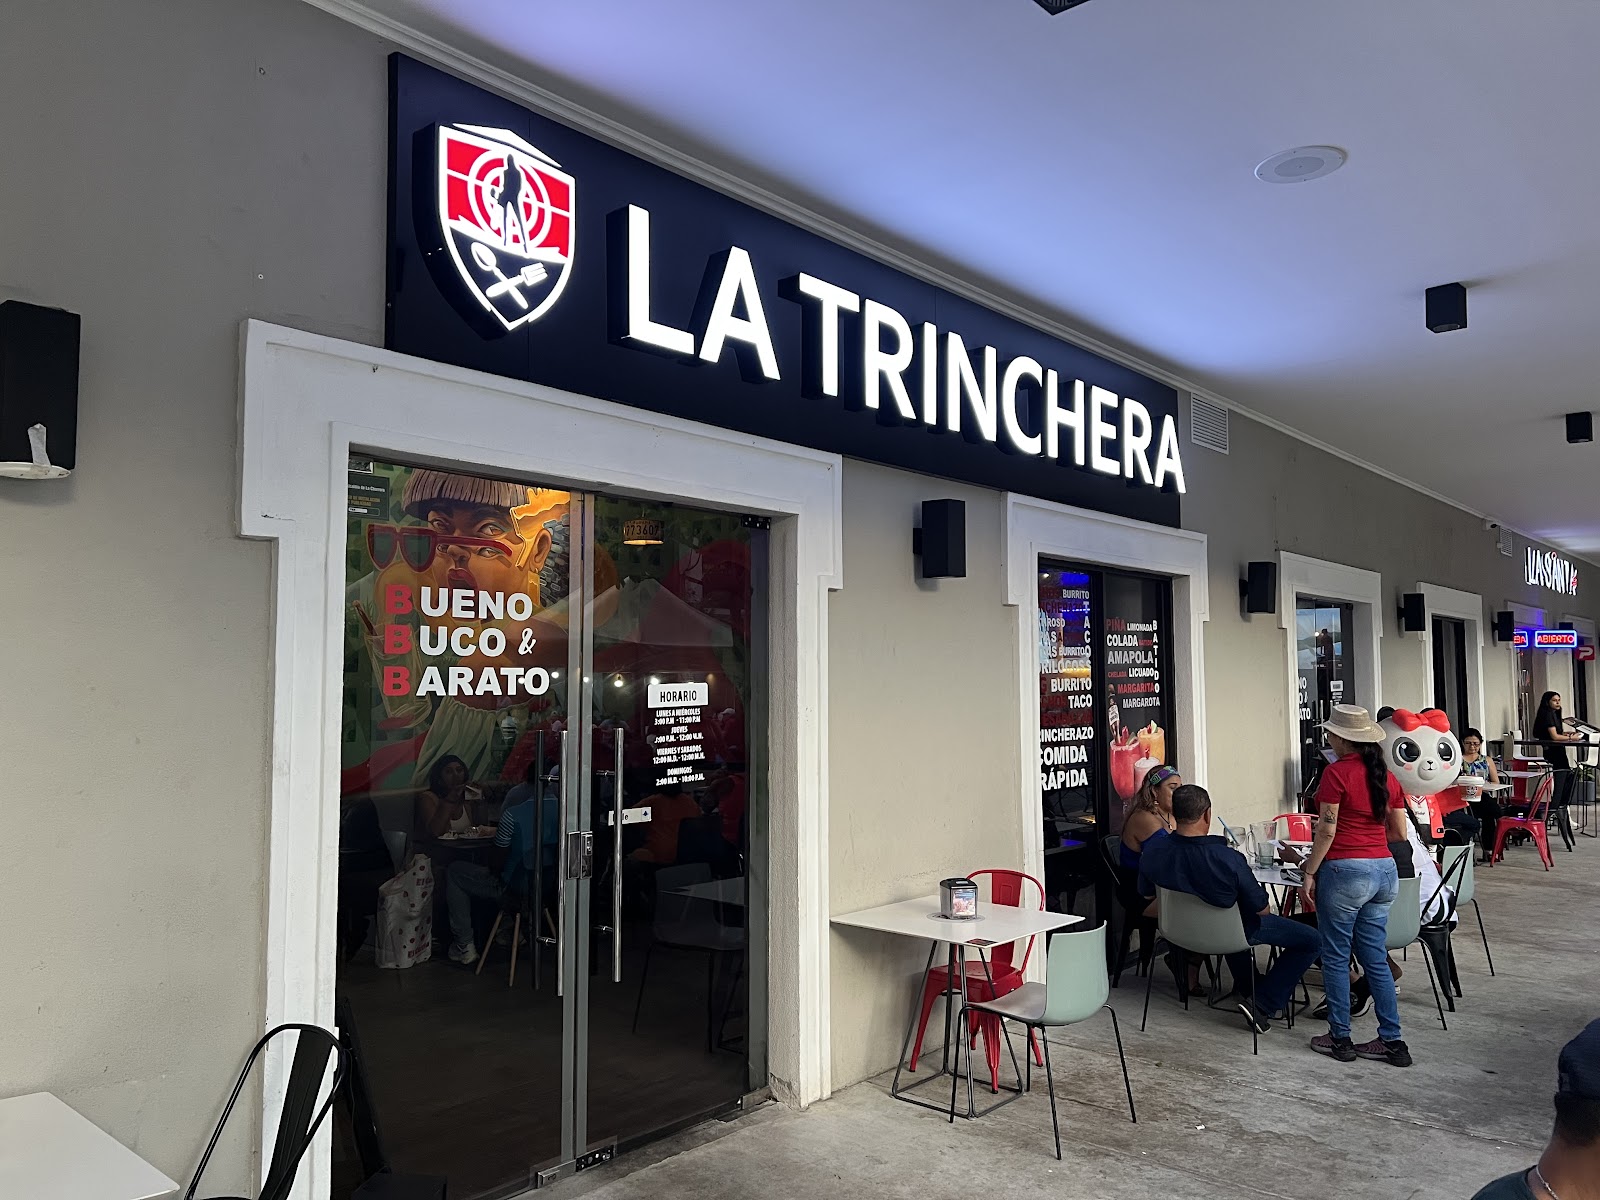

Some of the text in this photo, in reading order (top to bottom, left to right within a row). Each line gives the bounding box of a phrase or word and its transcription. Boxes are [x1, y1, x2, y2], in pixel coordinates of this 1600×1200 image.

[628, 203, 1187, 494] LA TRINCHERA
[1062, 588, 1090, 600] BURRITO
[384, 584, 533, 621] BUENO
[383, 624, 537, 657] BUCO &
[1106, 634, 1139, 647] COLADA
[1536, 633, 1575, 644] ABIERTO
[1107, 650, 1154, 665] AMAPOLA
[1128, 667, 1155, 677] LICUADO
[382, 665, 550, 697] BARATO
[1050, 677, 1093, 692] BURRITO
[1117, 682, 1155, 694] MARGARITA
[660, 690, 697, 702] HORARIO
[1068, 694, 1093, 709] TACO
[1122, 697, 1161, 709] MARGAROTA
